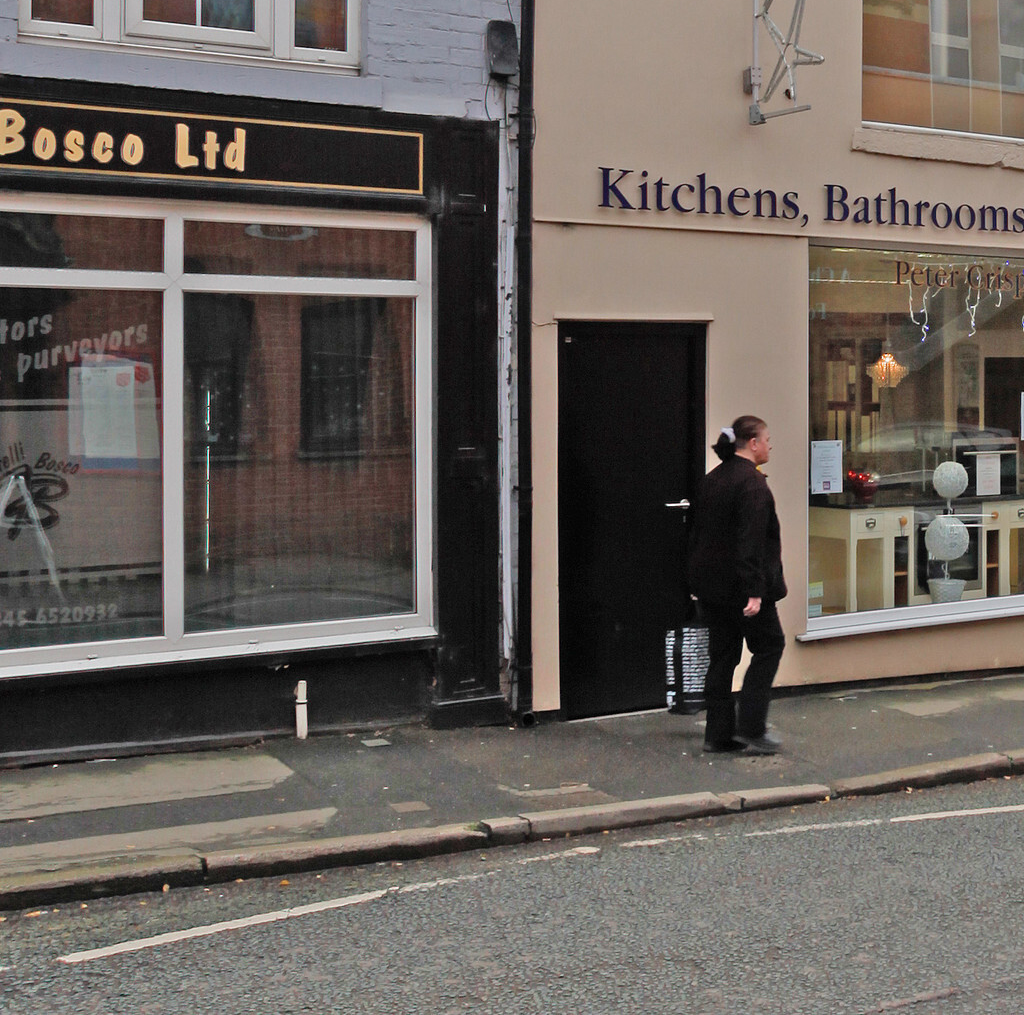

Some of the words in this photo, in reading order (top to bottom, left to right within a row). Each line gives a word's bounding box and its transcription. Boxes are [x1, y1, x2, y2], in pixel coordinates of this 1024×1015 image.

[0, 109, 144, 166] Bosco
[175, 123, 246, 172] Ltd
[598, 166, 809, 227] Kitchens,
[896, 260, 959, 289] Peter
[17, 324, 149, 383] purveyors
